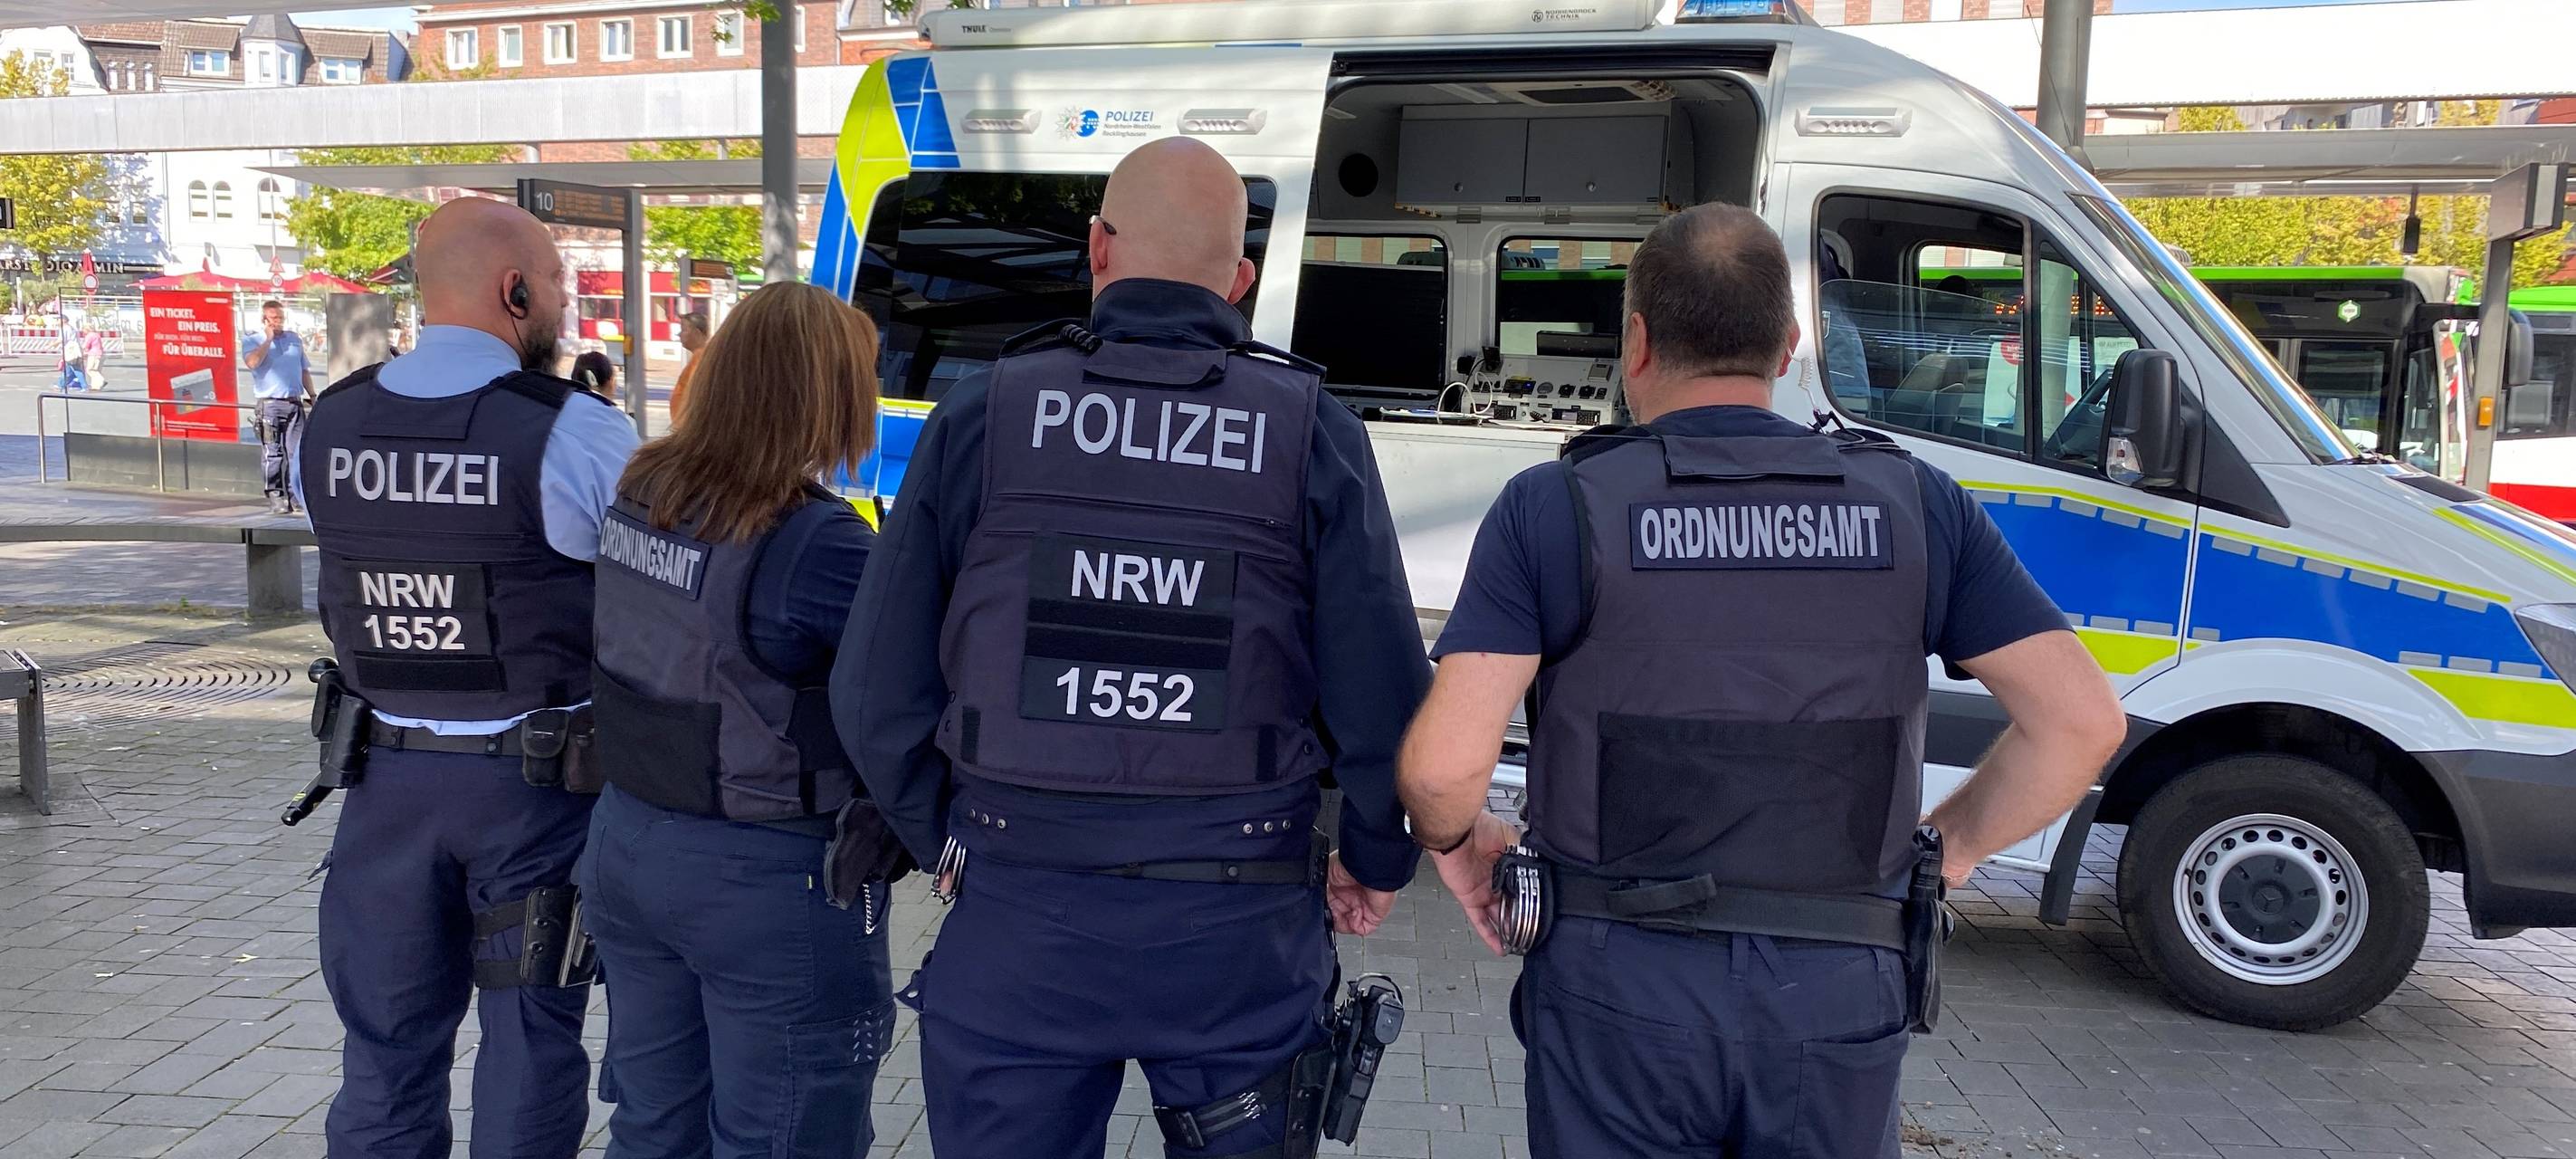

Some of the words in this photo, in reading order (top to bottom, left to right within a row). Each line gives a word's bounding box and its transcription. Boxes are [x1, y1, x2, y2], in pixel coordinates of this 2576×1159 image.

[962, 24, 986, 33] THULE
[1105, 110, 1154, 121] POLIZEI
[536, 192, 554, 211] 10
[149, 307, 165, 318] EIN
[166, 308, 196, 319] TICKET.
[177, 321, 193, 331] EIN
[194, 321, 221, 333] PREIS.
[163, 342, 180, 355] FÜR
[181, 343, 226, 359] ÜBERALLE.
[1031, 389, 1266, 474] POLIZEI
[329, 447, 499, 505] POLIZEI
[1640, 504, 1881, 560] ORDNUNGSAMT
[600, 516, 701, 590] ORDNUNGSAMT
[360, 571, 454, 608] NRW
[1071, 550, 1205, 607] NRW
[364, 614, 465, 650] 1552
[1056, 666, 1195, 723] 1552
